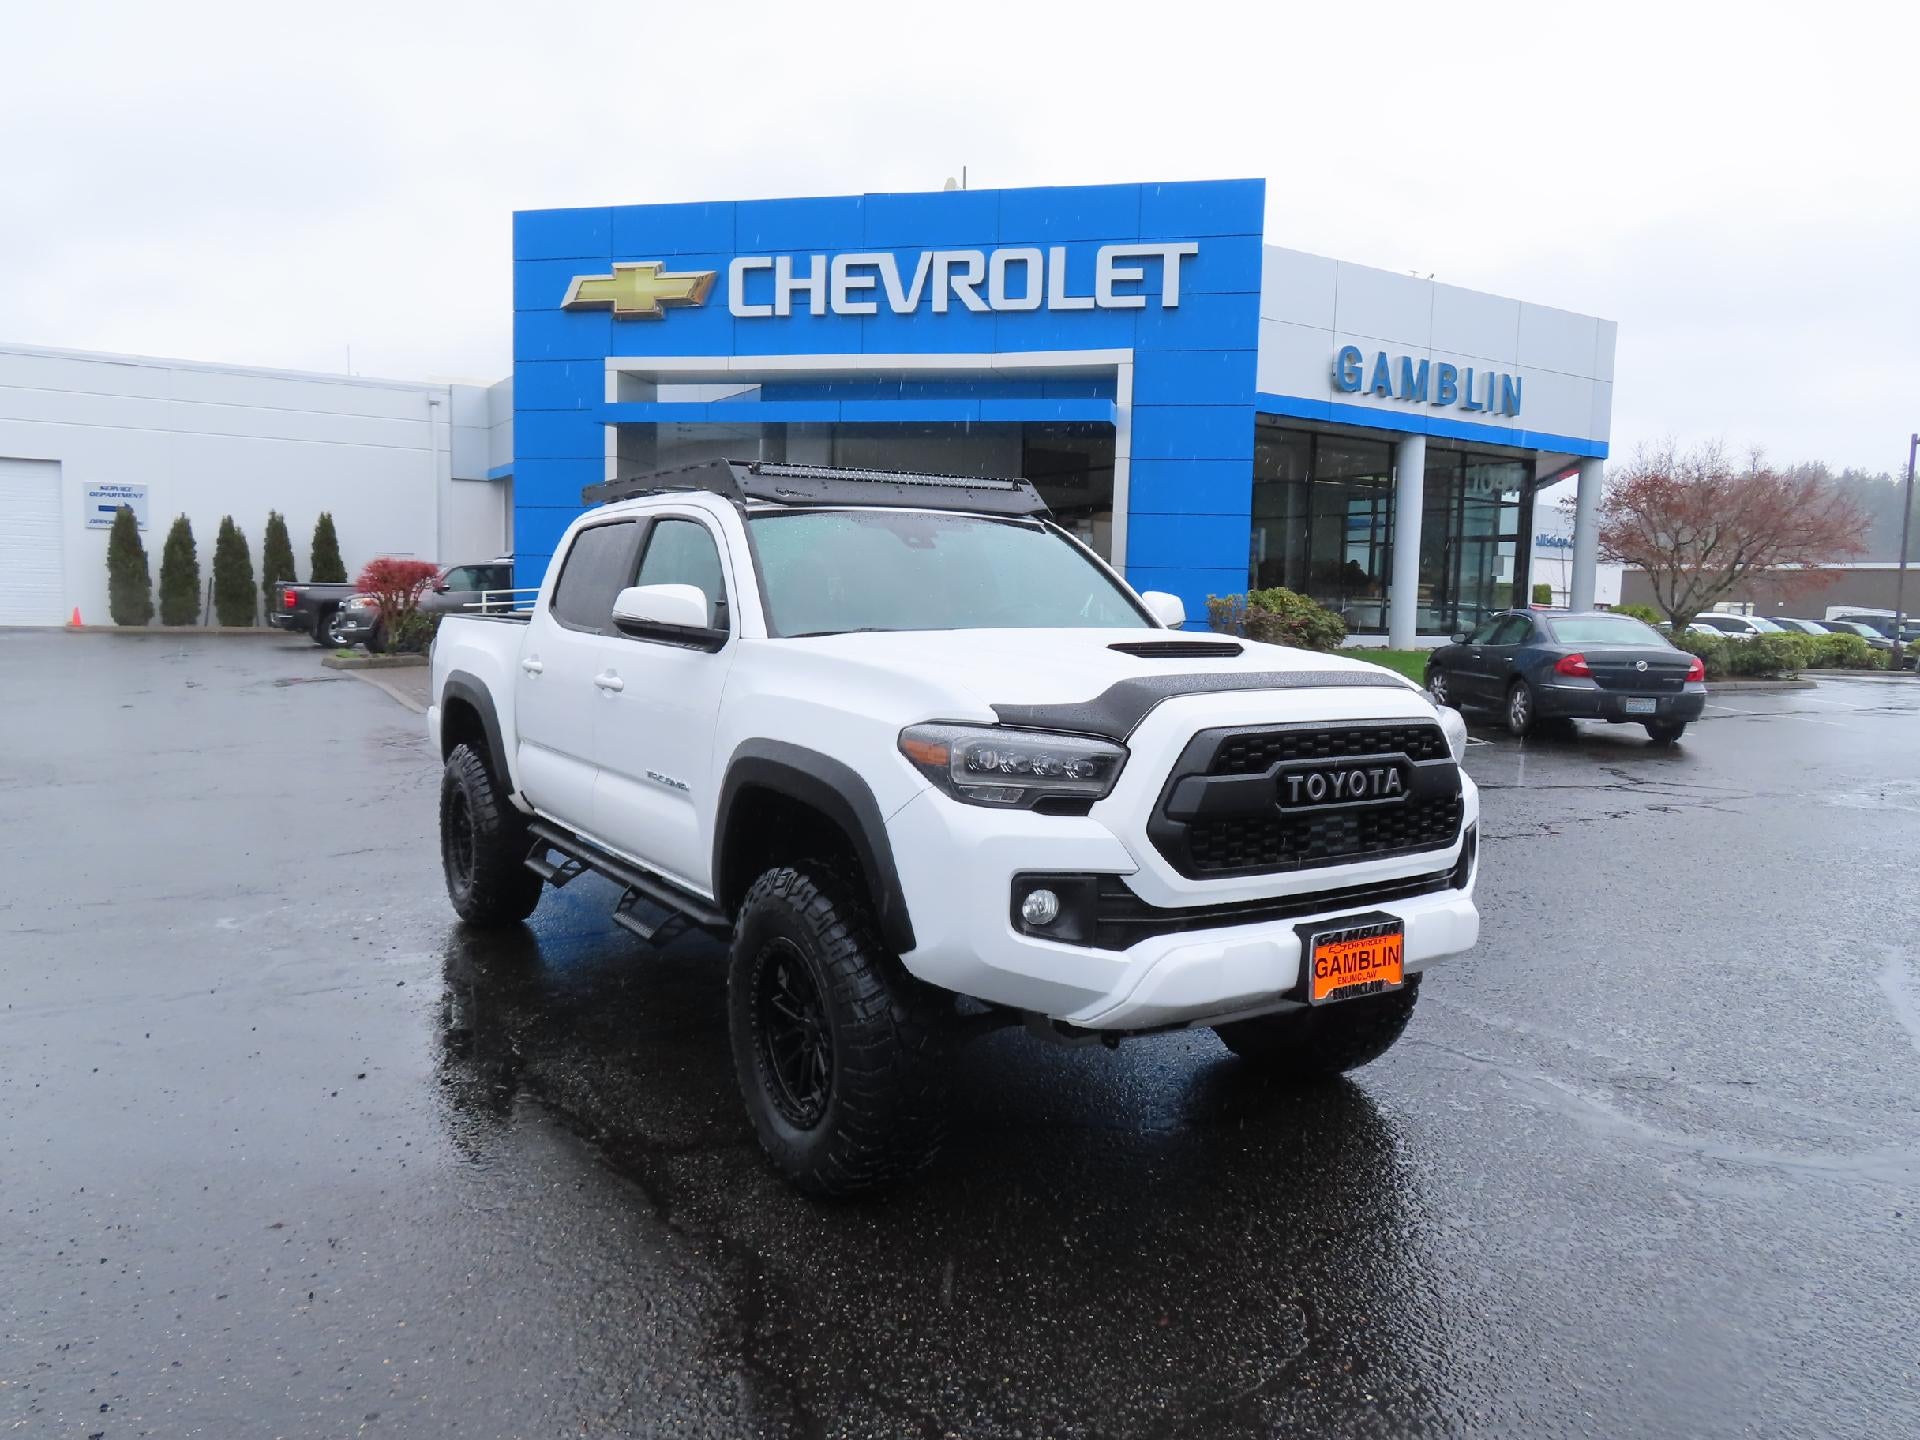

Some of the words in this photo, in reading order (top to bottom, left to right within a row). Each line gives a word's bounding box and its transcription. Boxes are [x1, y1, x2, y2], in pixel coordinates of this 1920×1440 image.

[727, 241, 1200, 317] CHEVROLET
[1332, 344, 1522, 418] GAMBLIN
[1287, 767, 1401, 802] TOYOTA
[1317, 921, 1400, 946] GAMBLIN
[1347, 938, 1387, 950] CHEVROLET
[1315, 944, 1400, 979] GAMBLIN
[1337, 970, 1377, 985] ENUMCLAW
